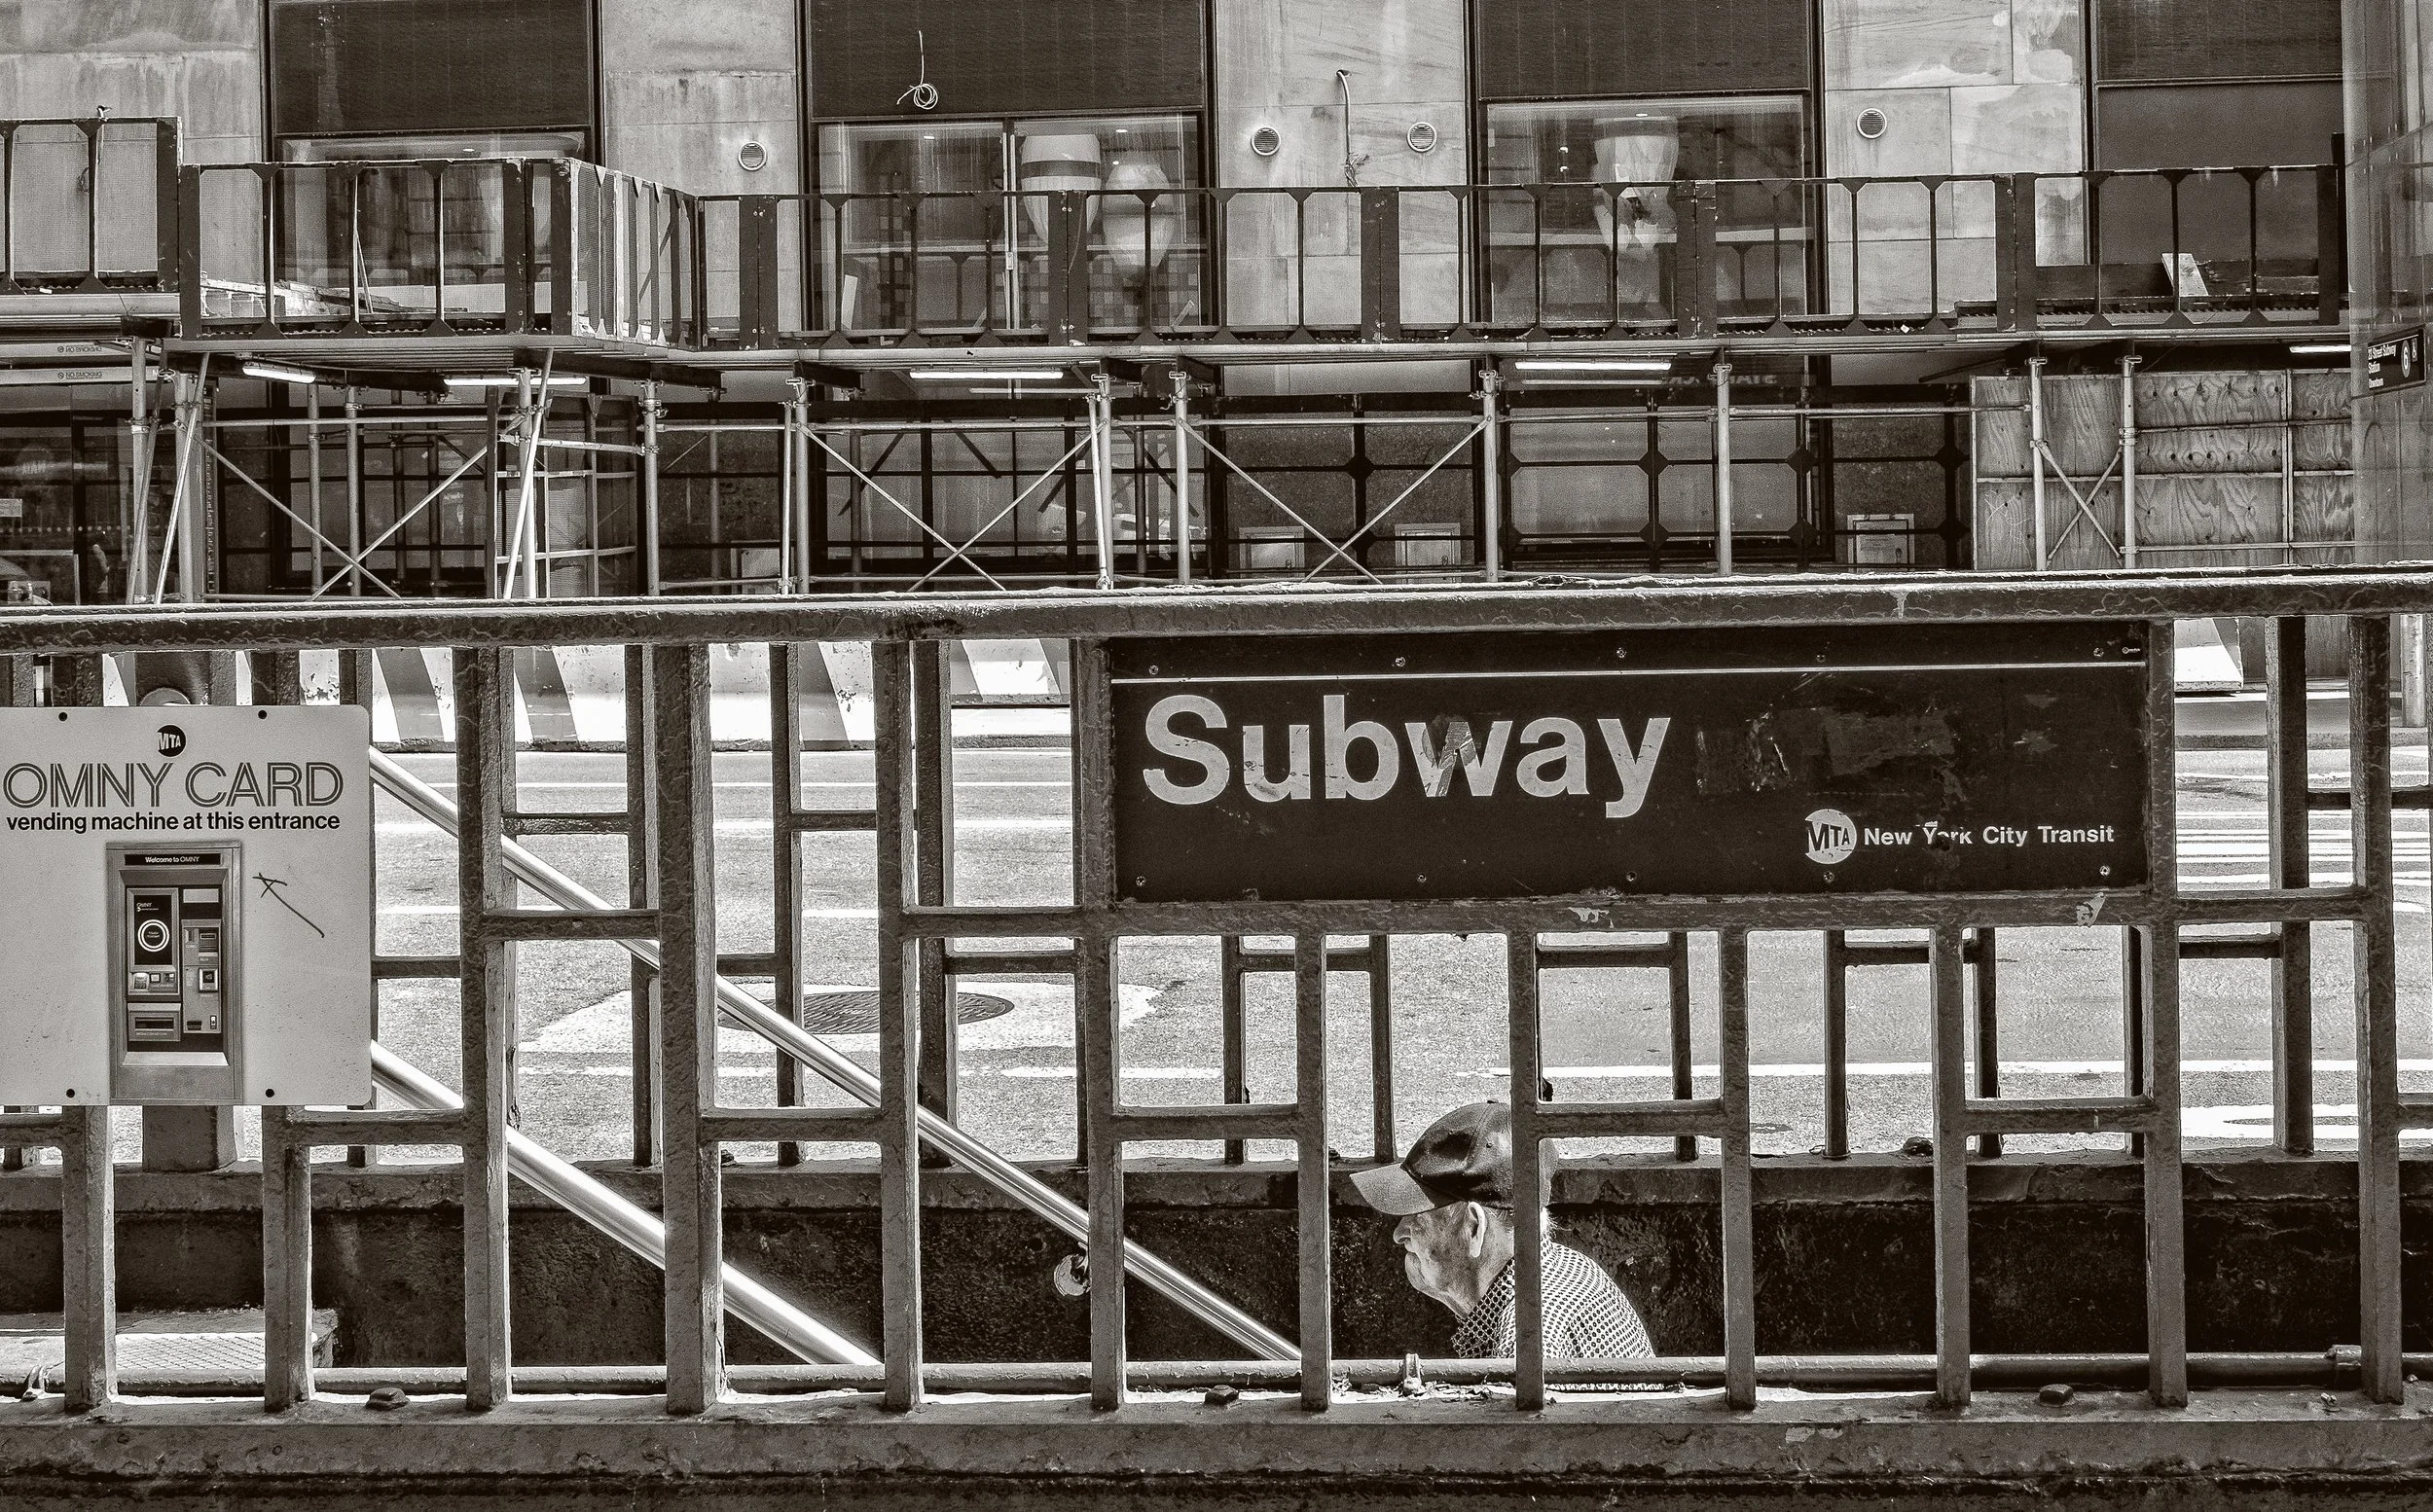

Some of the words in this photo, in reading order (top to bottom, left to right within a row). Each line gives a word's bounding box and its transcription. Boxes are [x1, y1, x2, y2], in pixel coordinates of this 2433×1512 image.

[157, 730, 183, 751] MTA
[1143, 694, 1671, 818] Subway
[3, 762, 174, 809] OMNY
[185, 762, 344, 809] CARD
[6, 811, 87, 834] vending
[91, 811, 179, 830] machine
[183, 813, 203, 830] at
[206, 811, 244, 830] this
[248, 813, 341, 830] entrance
[1806, 819, 1852, 856] MTA
[1864, 827, 1913, 846] New
[1982, 825, 2028, 847] City
[2037, 824, 2115, 844] Transit
